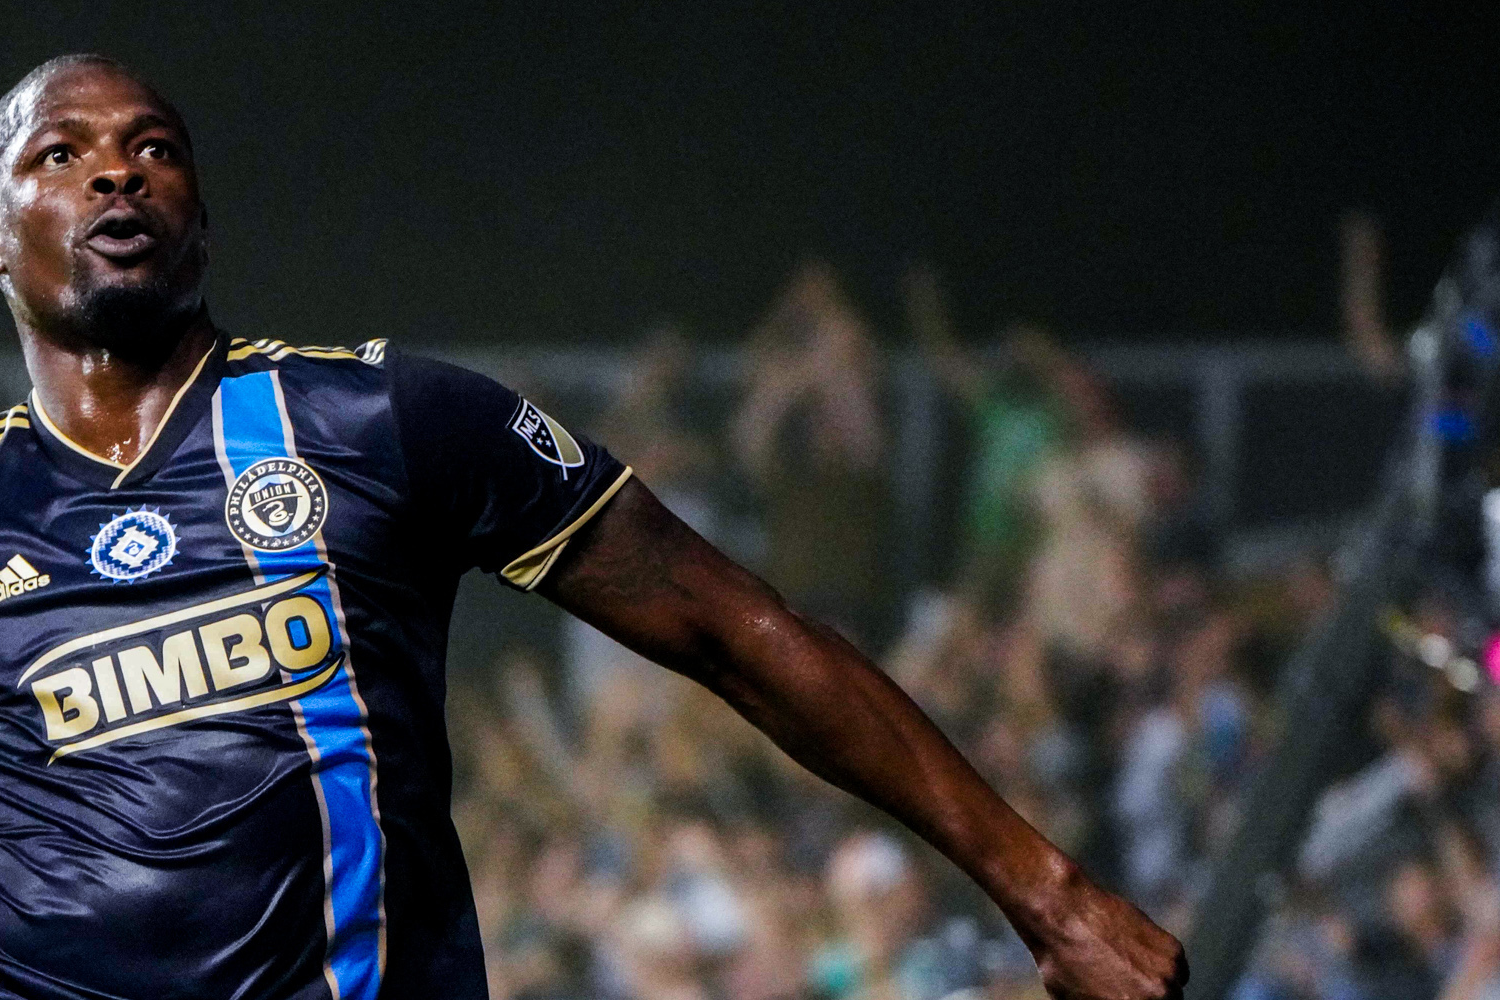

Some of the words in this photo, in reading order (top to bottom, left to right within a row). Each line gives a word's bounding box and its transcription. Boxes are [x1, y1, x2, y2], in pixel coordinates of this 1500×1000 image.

[519, 410, 542, 440] MLS
[230, 462, 319, 516] PHILADELPHIA
[254, 483, 292, 503] UNION
[31, 596, 332, 741] BIMBO
